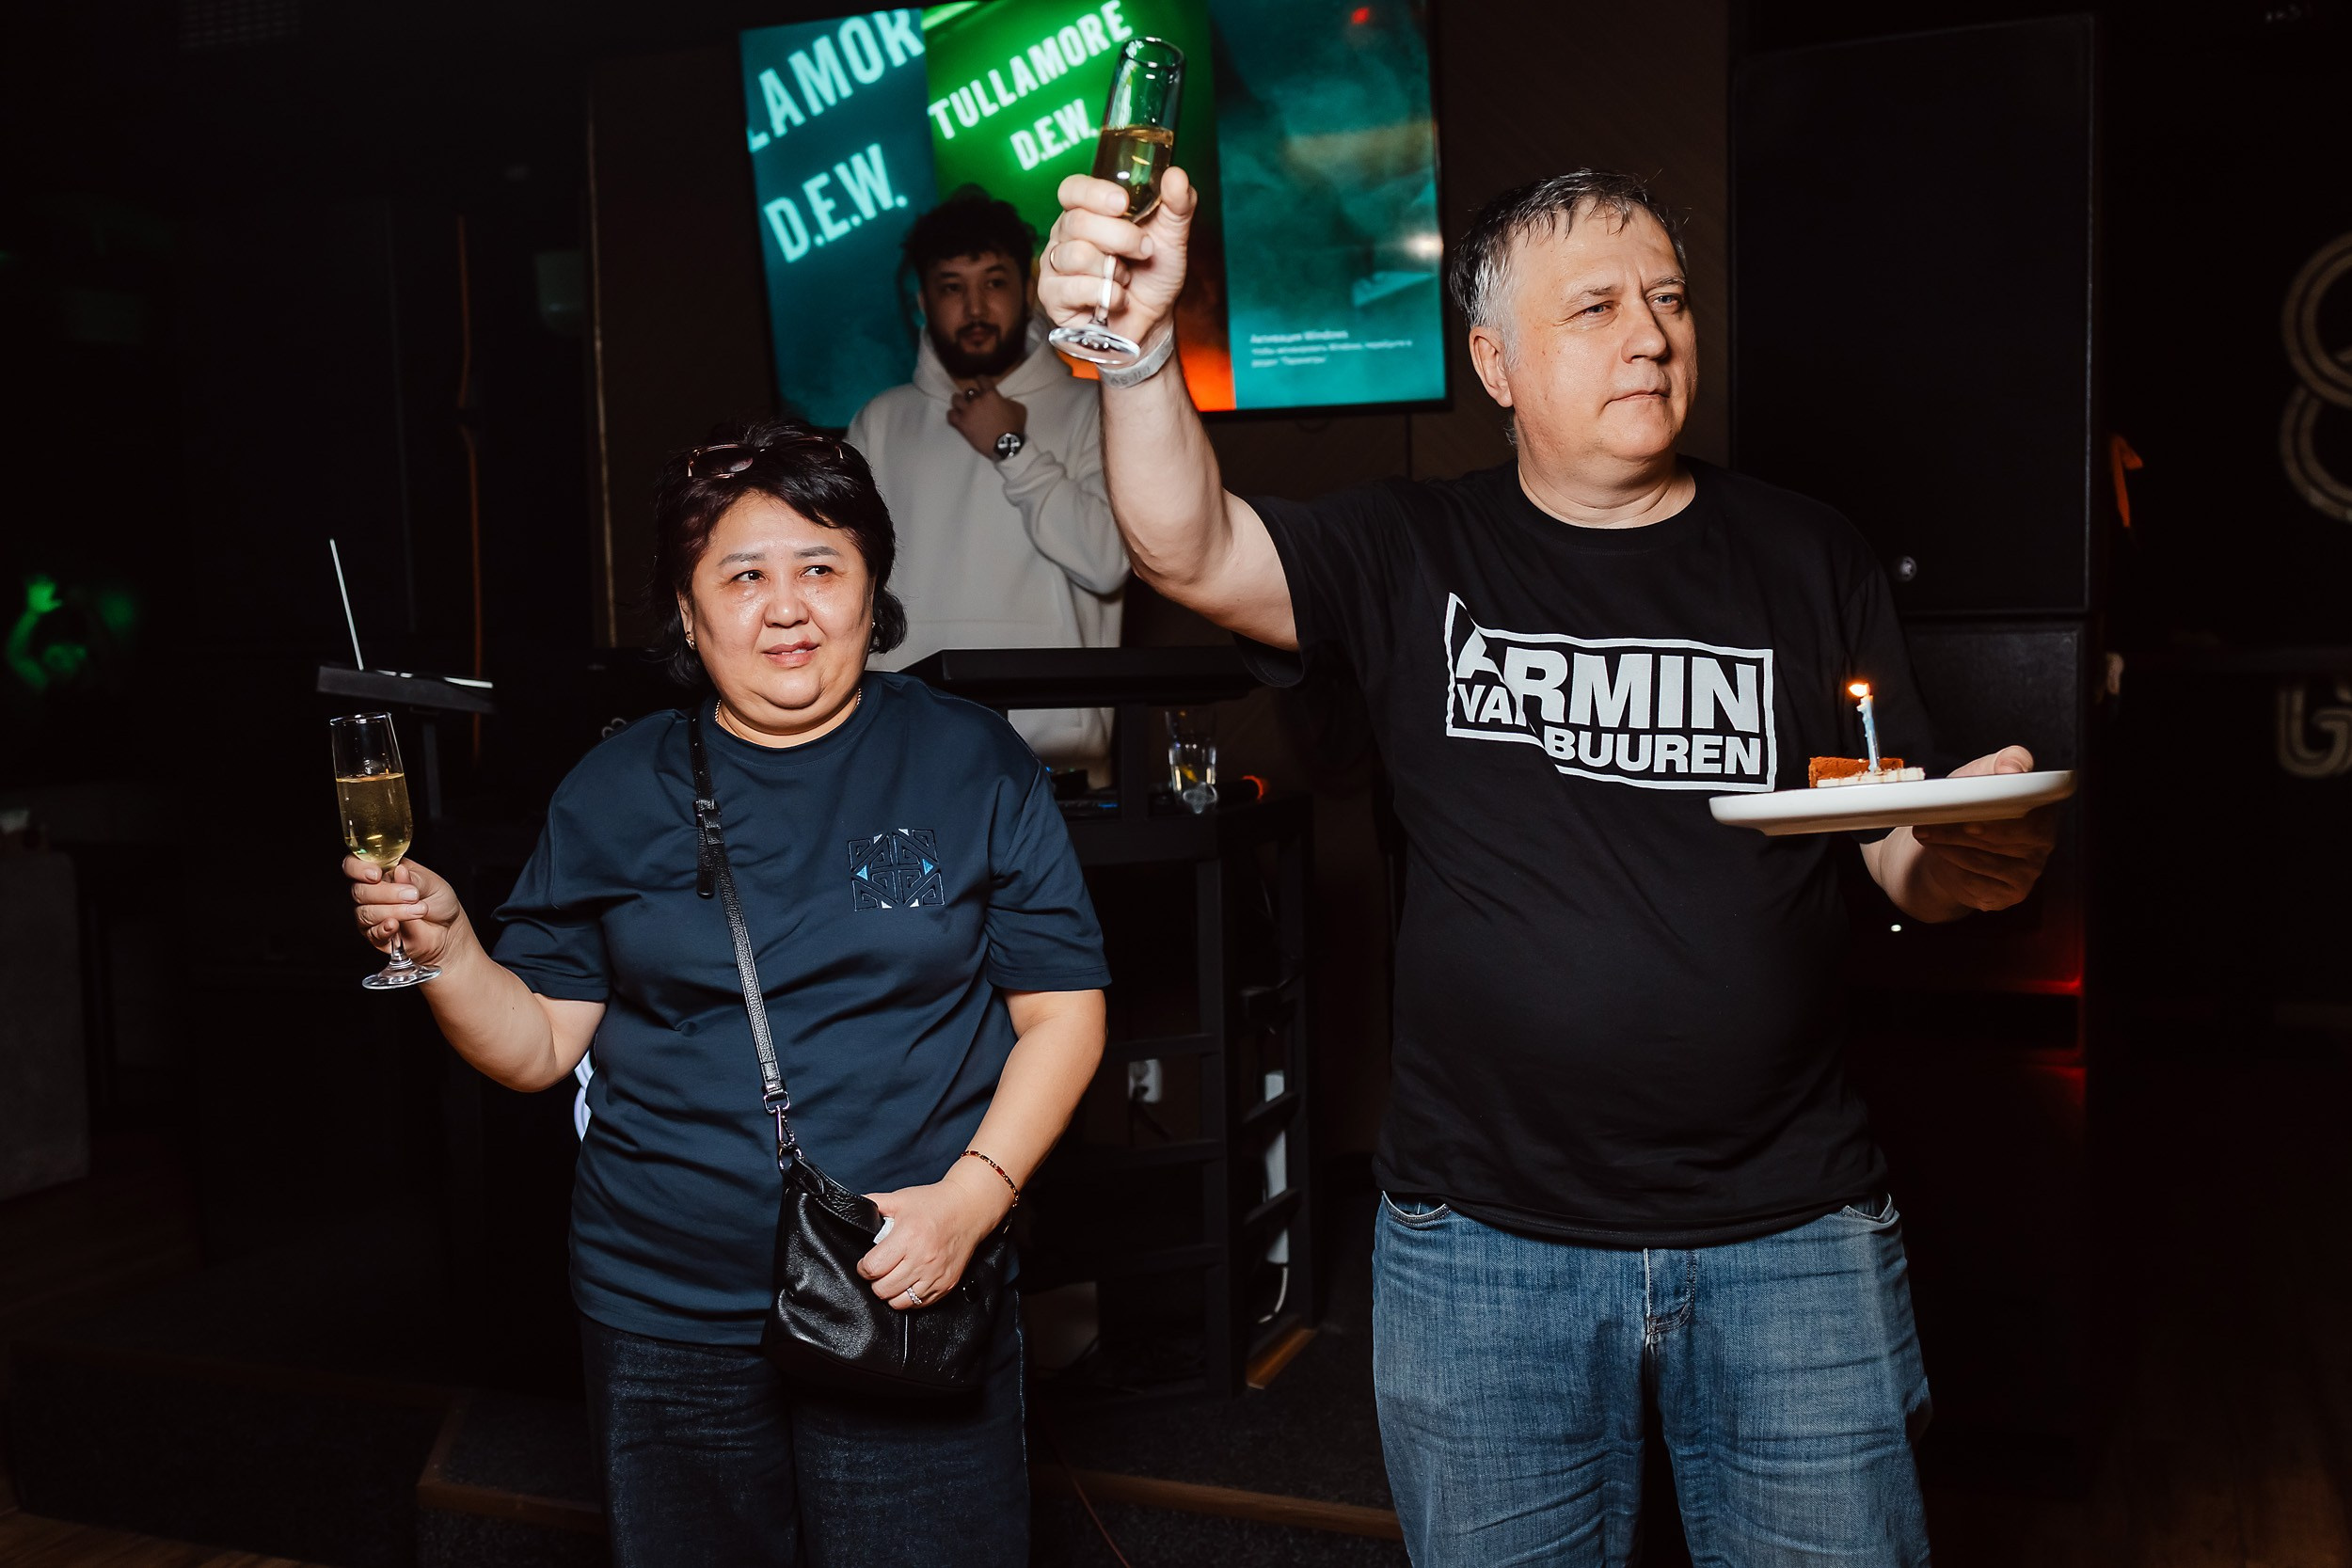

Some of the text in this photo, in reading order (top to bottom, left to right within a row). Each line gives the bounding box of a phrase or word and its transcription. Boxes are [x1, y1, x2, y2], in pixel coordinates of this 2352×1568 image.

[927, 0, 1134, 139] TULLAMORE
[1009, 98, 1099, 171] D.E.W.
[763, 143, 909, 263] D.E.W.
[1544, 725, 1761, 774] BUUREN
